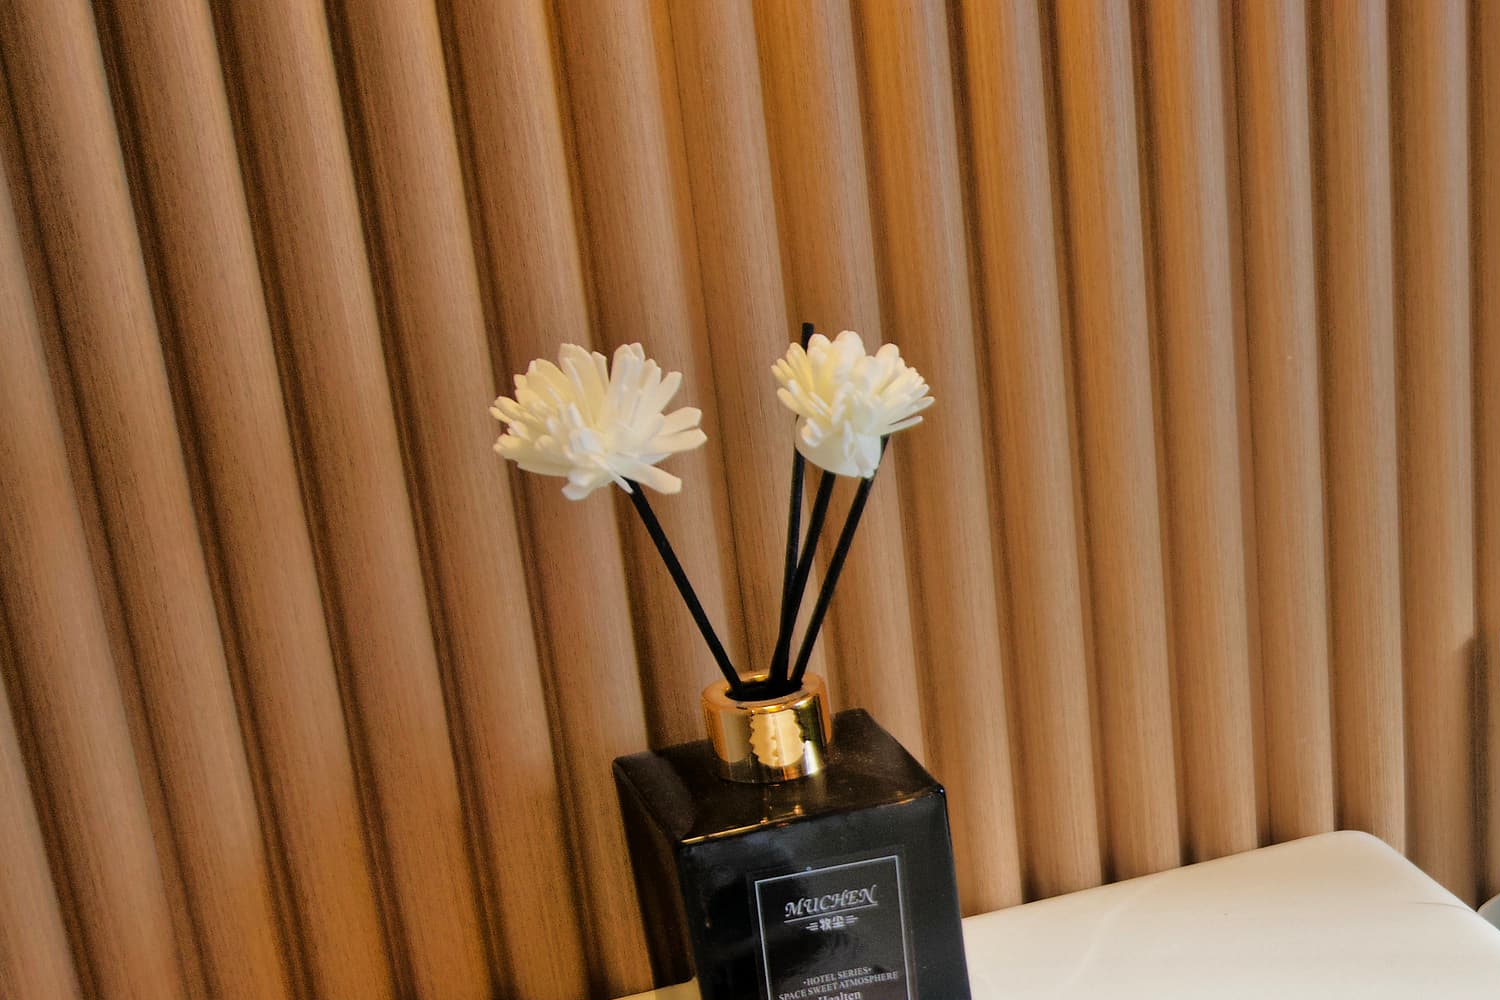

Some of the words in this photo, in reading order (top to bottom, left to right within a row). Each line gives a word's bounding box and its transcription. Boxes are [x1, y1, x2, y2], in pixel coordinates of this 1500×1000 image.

[784, 884, 878, 917] MUCHEN
[807, 981, 839, 996] SWEET
[839, 970, 899, 989] ATMOSPHERE
